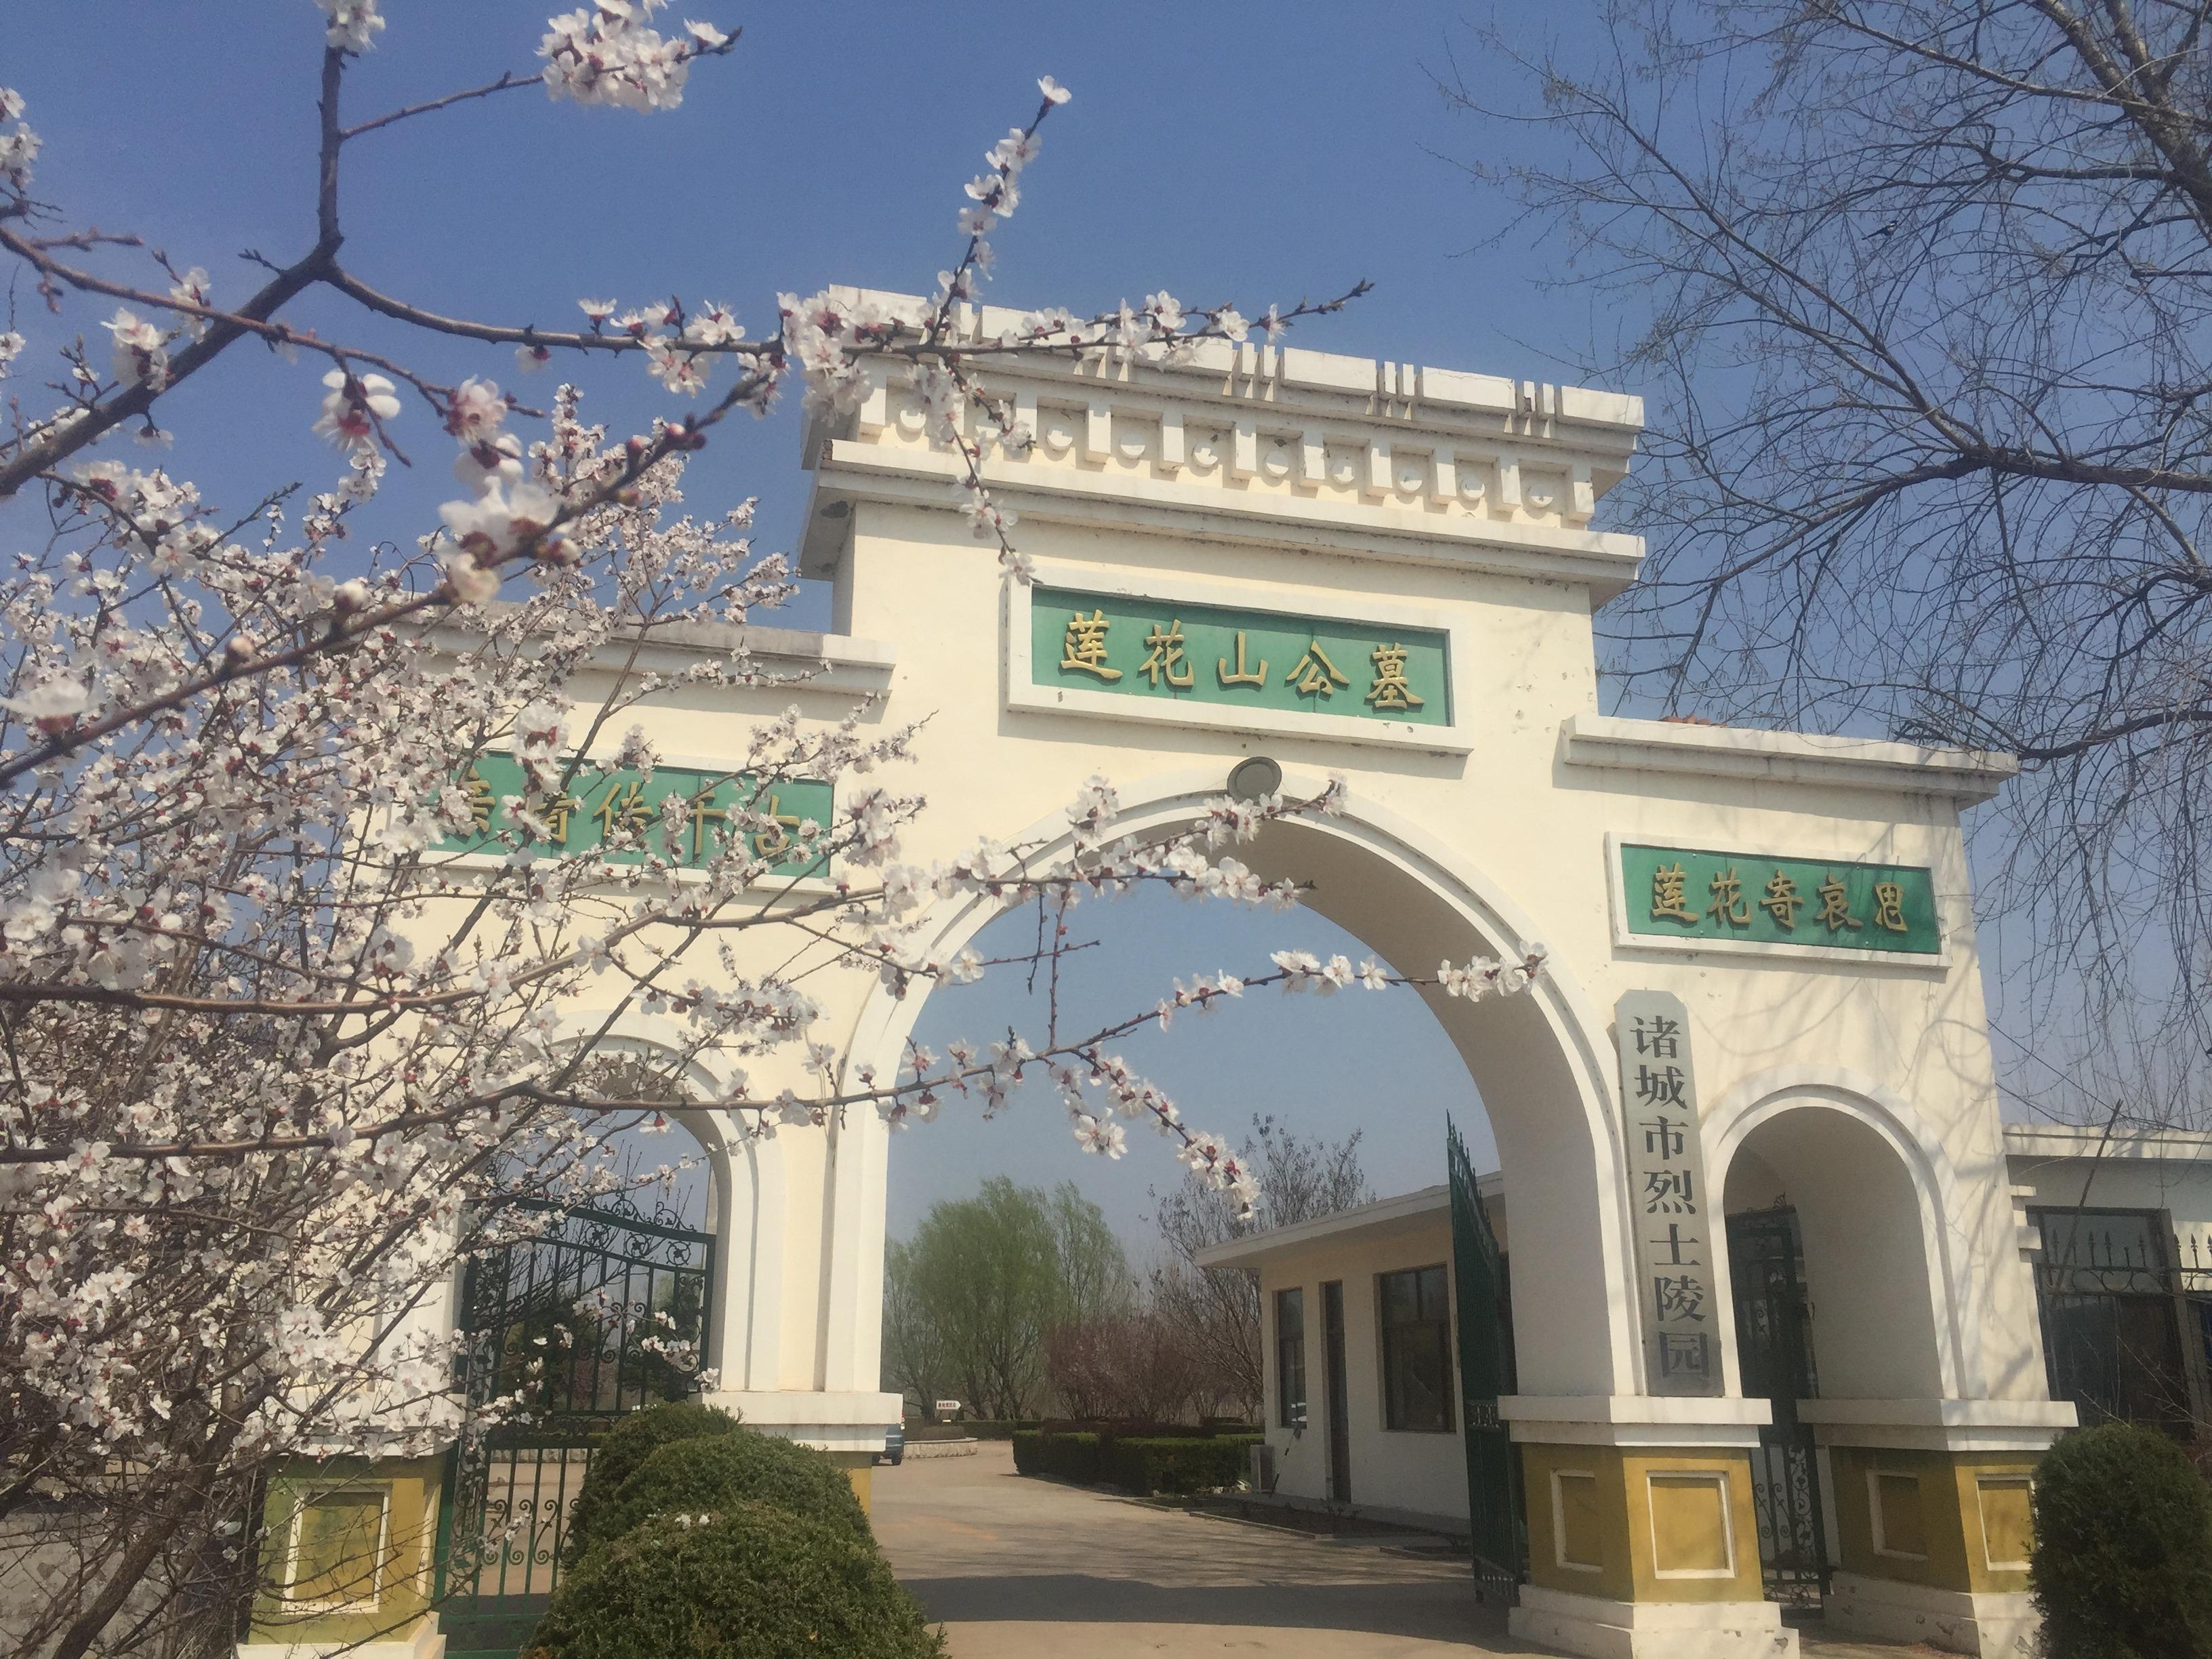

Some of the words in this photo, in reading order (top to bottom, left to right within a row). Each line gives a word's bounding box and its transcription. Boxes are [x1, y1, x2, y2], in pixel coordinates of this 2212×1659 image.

[1061, 609, 1425, 710] 莲花山公墓
[1652, 861, 1908, 932] 莲花寄哀思
[1629, 1015, 1709, 1378] 诸城市烈士陵园
